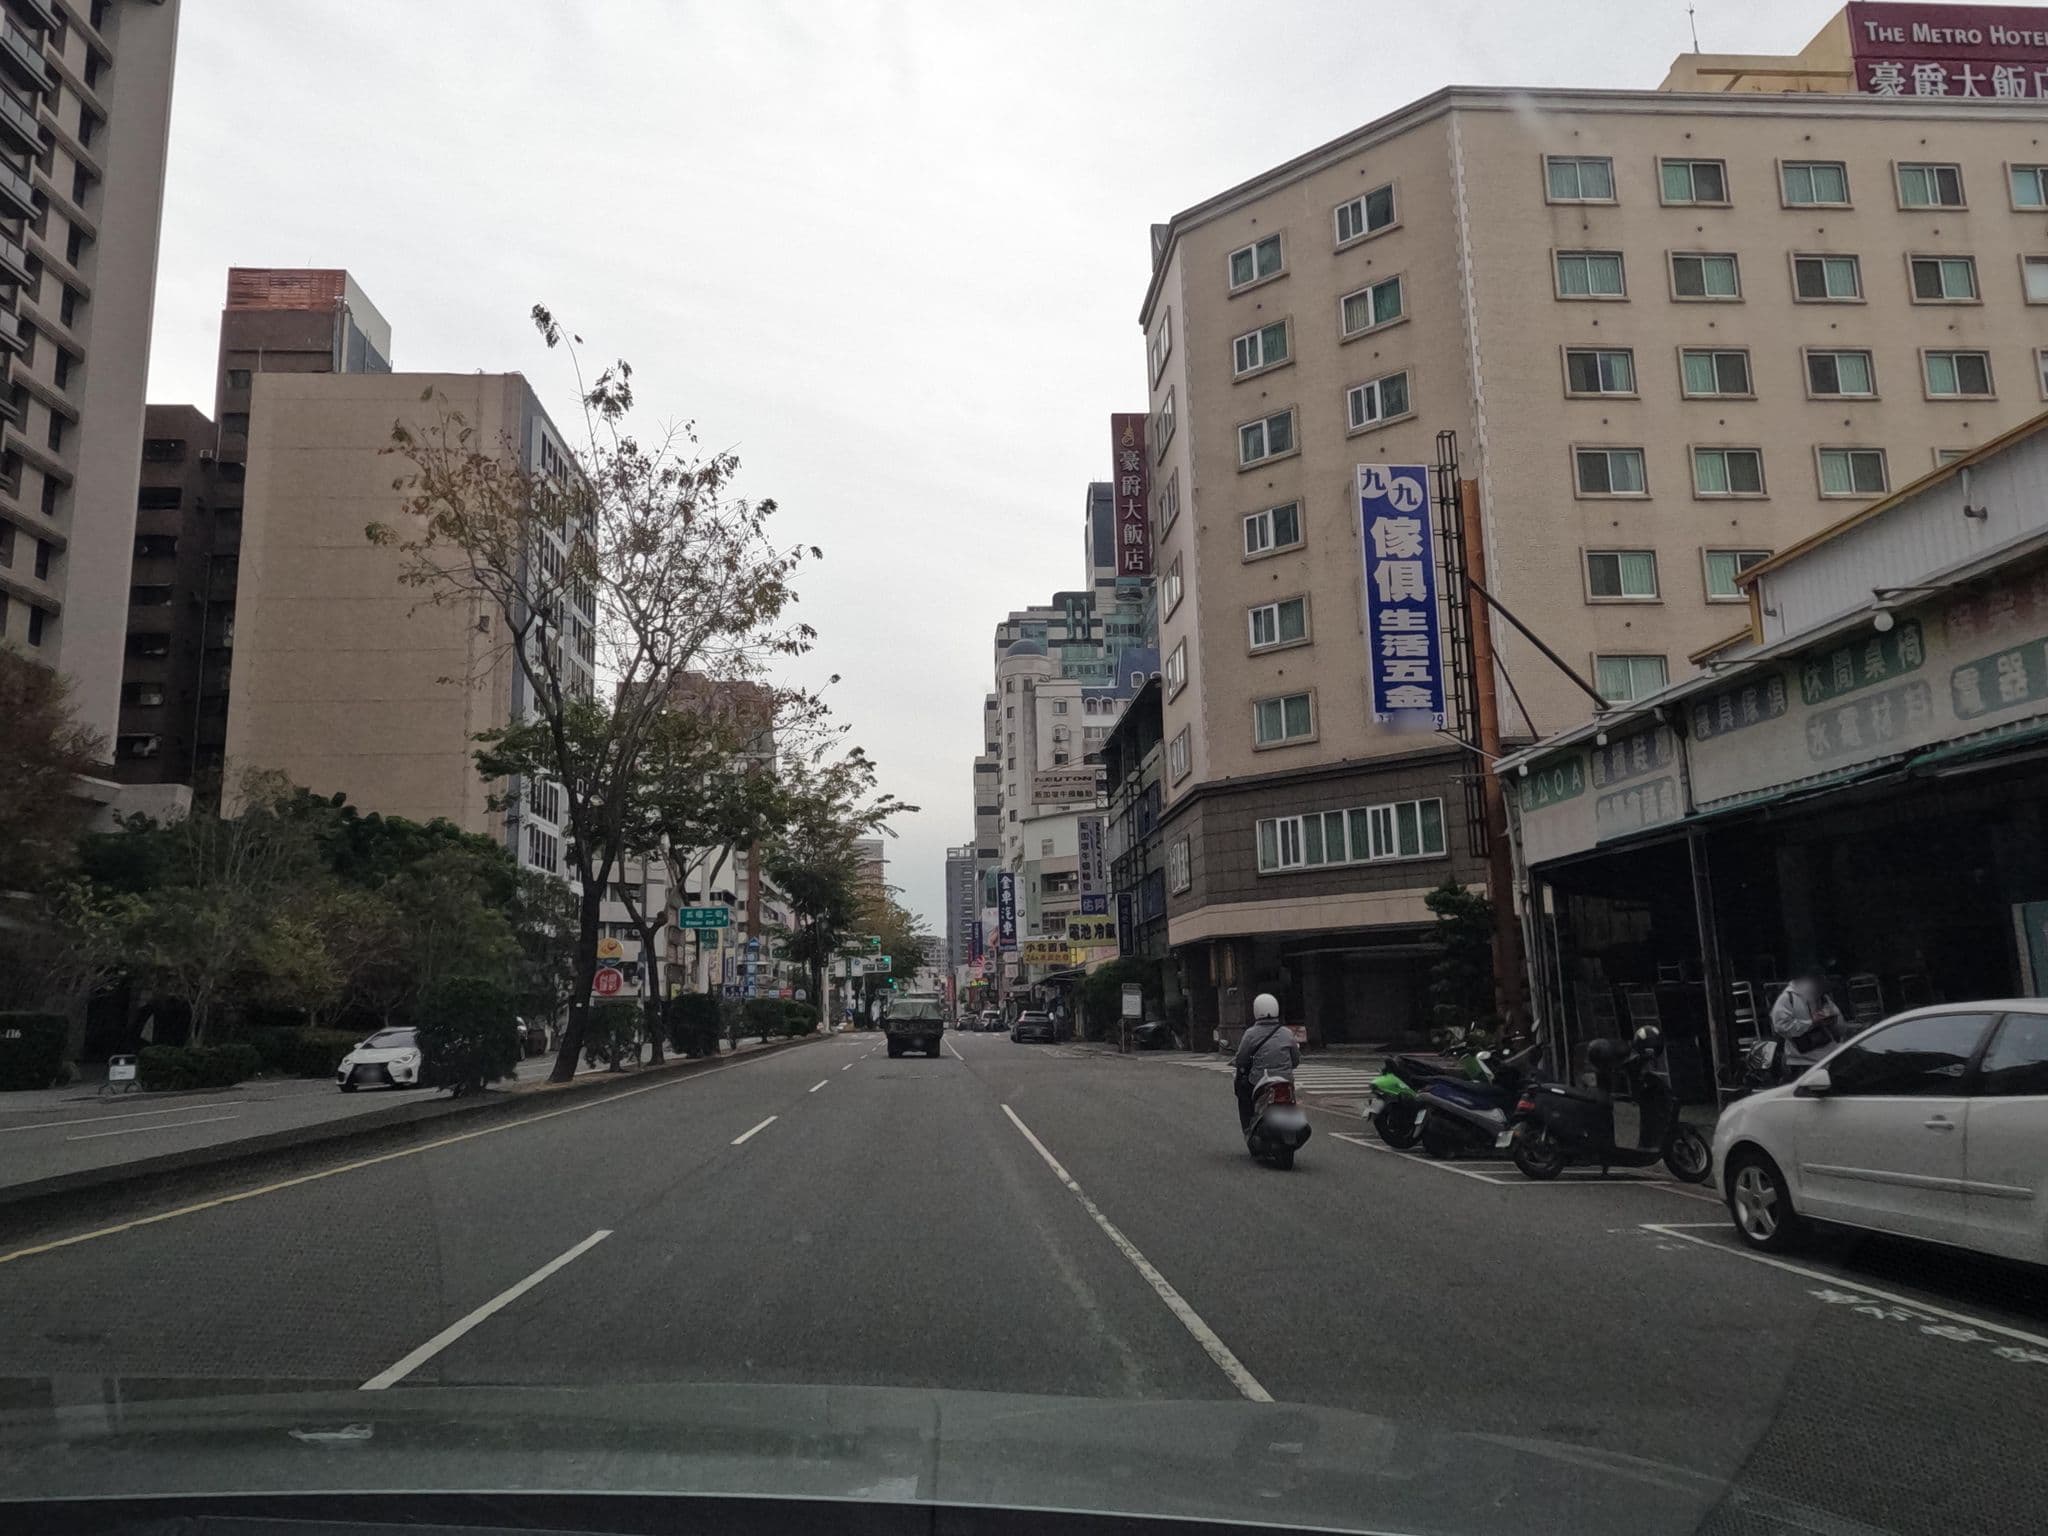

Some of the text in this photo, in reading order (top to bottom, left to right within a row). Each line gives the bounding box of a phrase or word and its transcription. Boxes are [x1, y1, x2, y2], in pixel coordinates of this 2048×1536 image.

[1119, 449, 1145, 572] 豪爵大飯店
